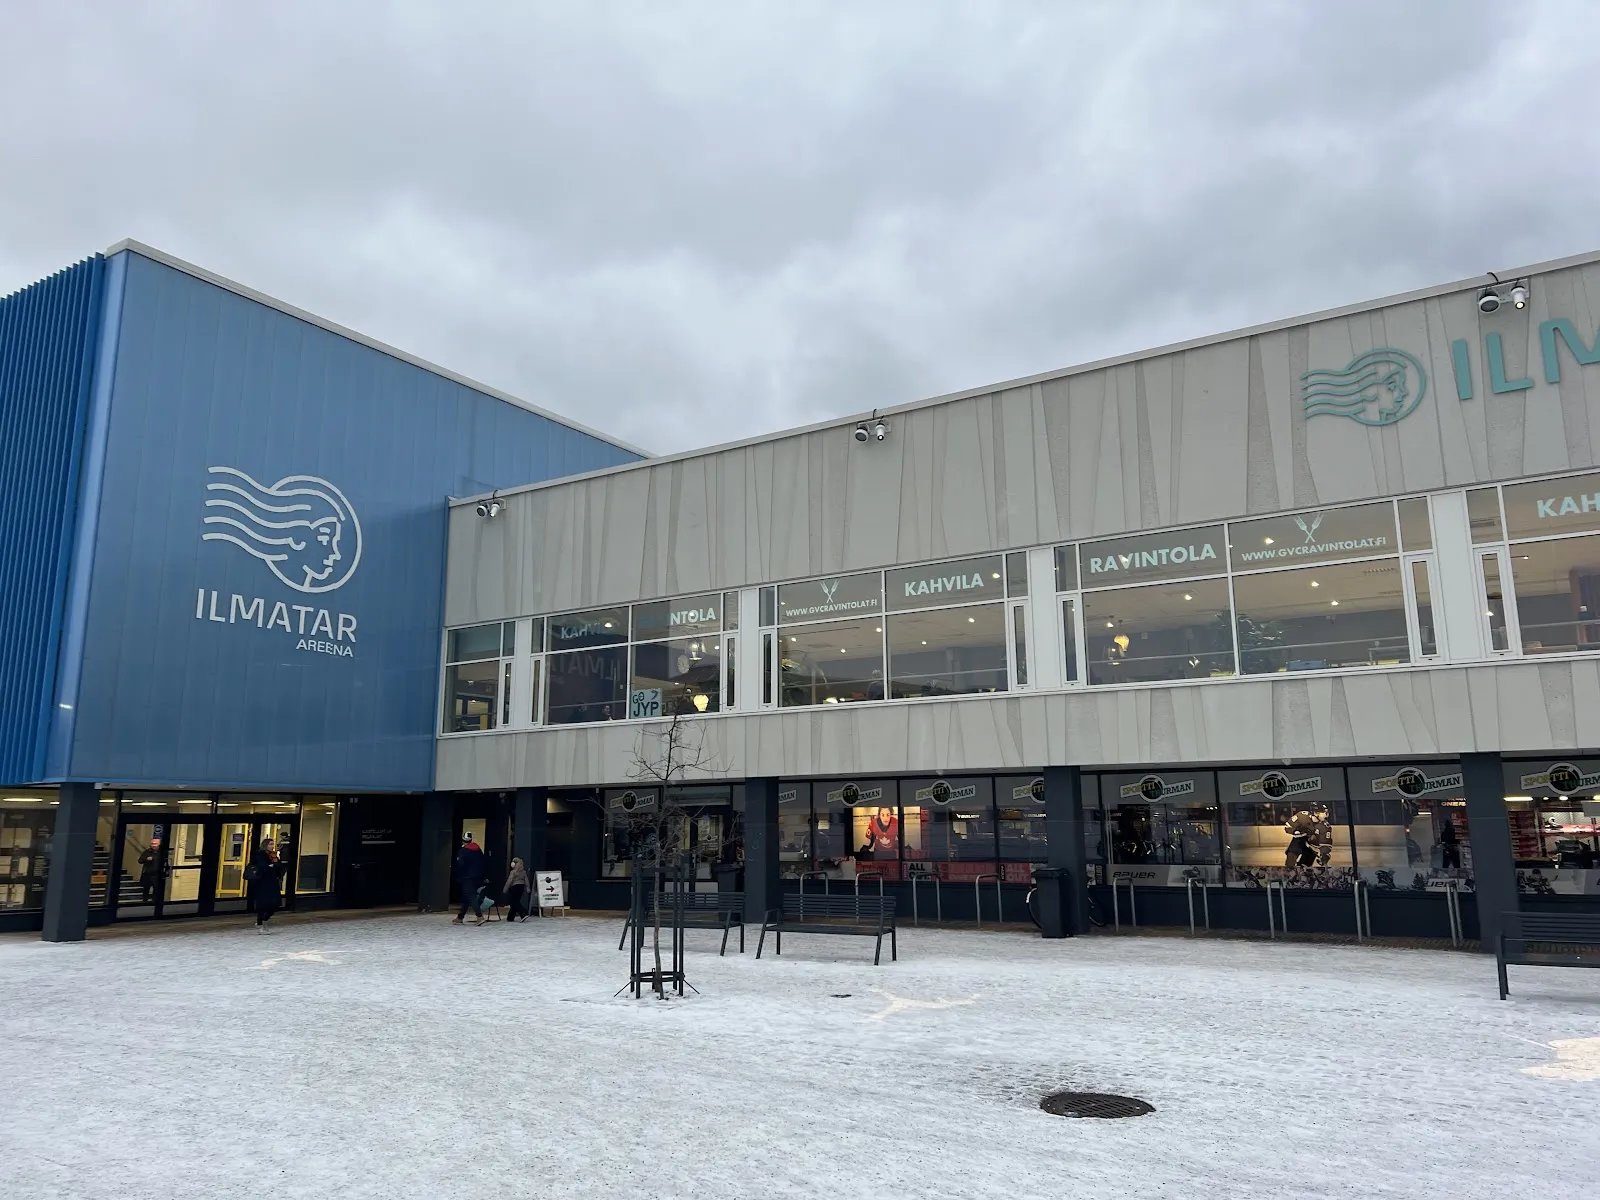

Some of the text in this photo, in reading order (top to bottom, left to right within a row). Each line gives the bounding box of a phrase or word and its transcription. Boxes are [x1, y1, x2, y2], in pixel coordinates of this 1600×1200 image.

[1537, 492, 1600, 518] KAH
[1241, 536, 1387, 561] WWW.GVCRAVINTOLAT.FI
[1090, 543, 1216, 574] RAVINTOLA
[904, 572, 984, 596] KAHVILA
[195, 588, 357, 643] ILMATAR
[785, 598, 878, 617] WWW.GVCRAVINTOLAT.FI
[295, 638, 354, 658] AREENA
[633, 701, 659, 717] JYP
[1241, 778, 1279, 795] SPORTTI
[1272, 779, 1319, 796] THURMAN
[1374, 774, 1416, 790] SPORTTI
[1408, 776, 1461, 793] THURMAN
[1523, 771, 1569, 788] SPORTTI
[916, 786, 944, 800] SPORTTI
[1122, 781, 1156, 796] SPORTTI
[1150, 782, 1192, 798] THURMAN
[909, 863, 925, 871] ALL
[1112, 871, 1156, 880] BAUER
